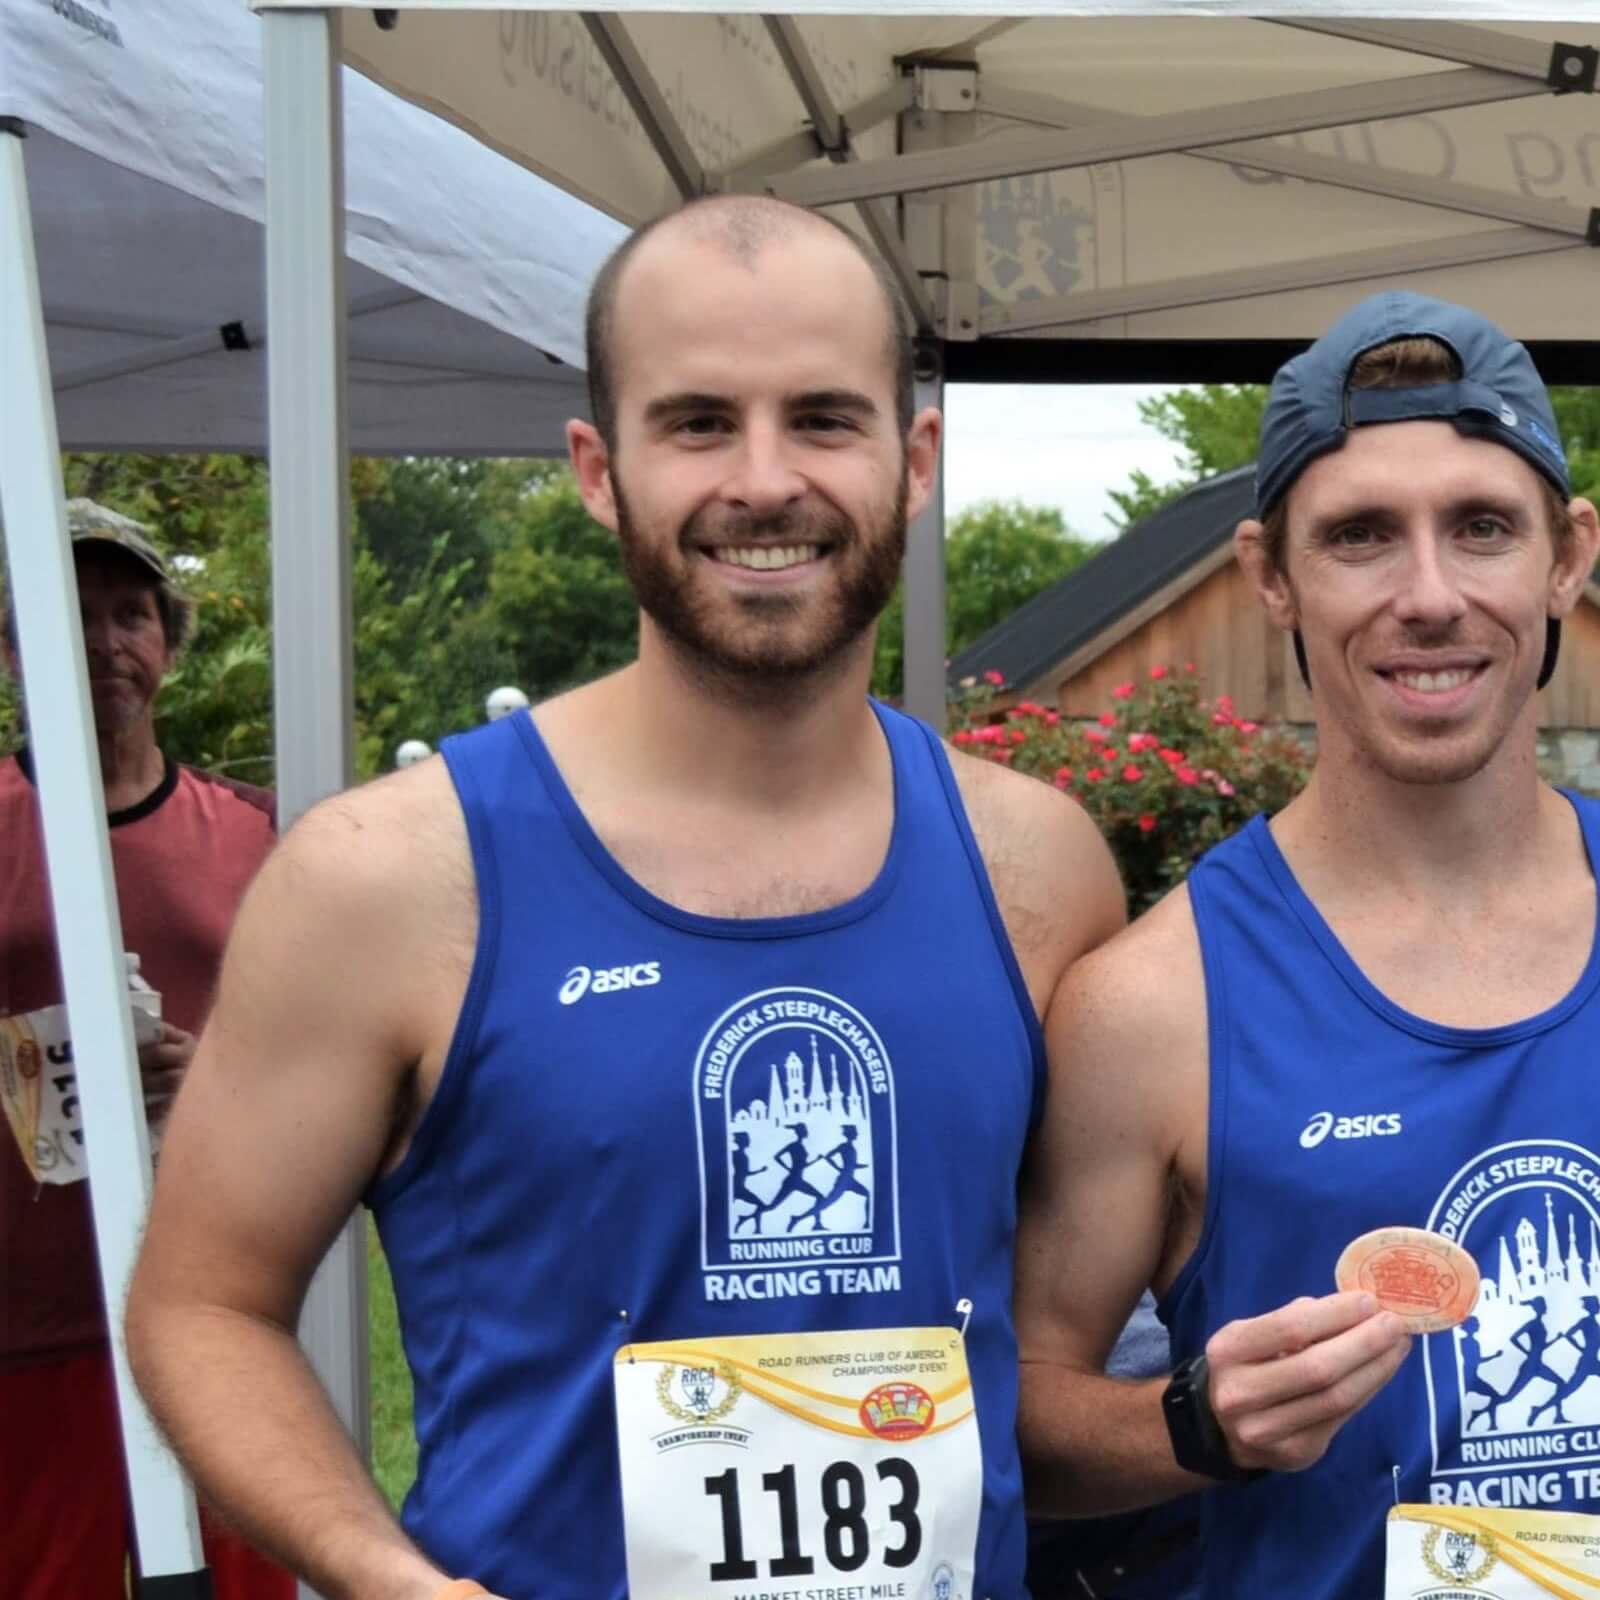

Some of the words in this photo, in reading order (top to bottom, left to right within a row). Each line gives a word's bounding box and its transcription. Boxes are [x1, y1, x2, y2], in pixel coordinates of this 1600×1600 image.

[591, 962, 661, 993] asics
[704, 1009, 763, 1100] FREDERICK
[762, 1000, 888, 1095] STEEPLECHASERS
[1334, 1114, 1402, 1139] asics
[1440, 1171, 1491, 1242] DERICK
[730, 1238, 825, 1261] RUNNING
[828, 1236, 873, 1255] CLUB
[704, 1272, 821, 1301] RACING
[825, 1266, 902, 1294] TEAM
[758, 1356, 797, 1369] ROAD
[799, 1353, 851, 1367] RUNNERS
[854, 1350, 885, 1363] CLUB
[887, 1350, 902, 1361] OF
[904, 1348, 946, 1361] AMERICA
[832, 1364, 917, 1378] CHAMPIONSHIP
[918, 1361, 948, 1374] EVENT
[681, 1367, 716, 1384] RRCA
[1461, 1434, 1567, 1462] RUNNING
[1430, 1471, 1562, 1507] RACING
[704, 1457, 922, 1581] 1183
[1515, 1531, 1548, 1542] ROAD
[1550, 1532, 1600, 1546] RUNNERS
[806, 1586, 865, 1600] STREET
[870, 1583, 905, 1599] MILE
